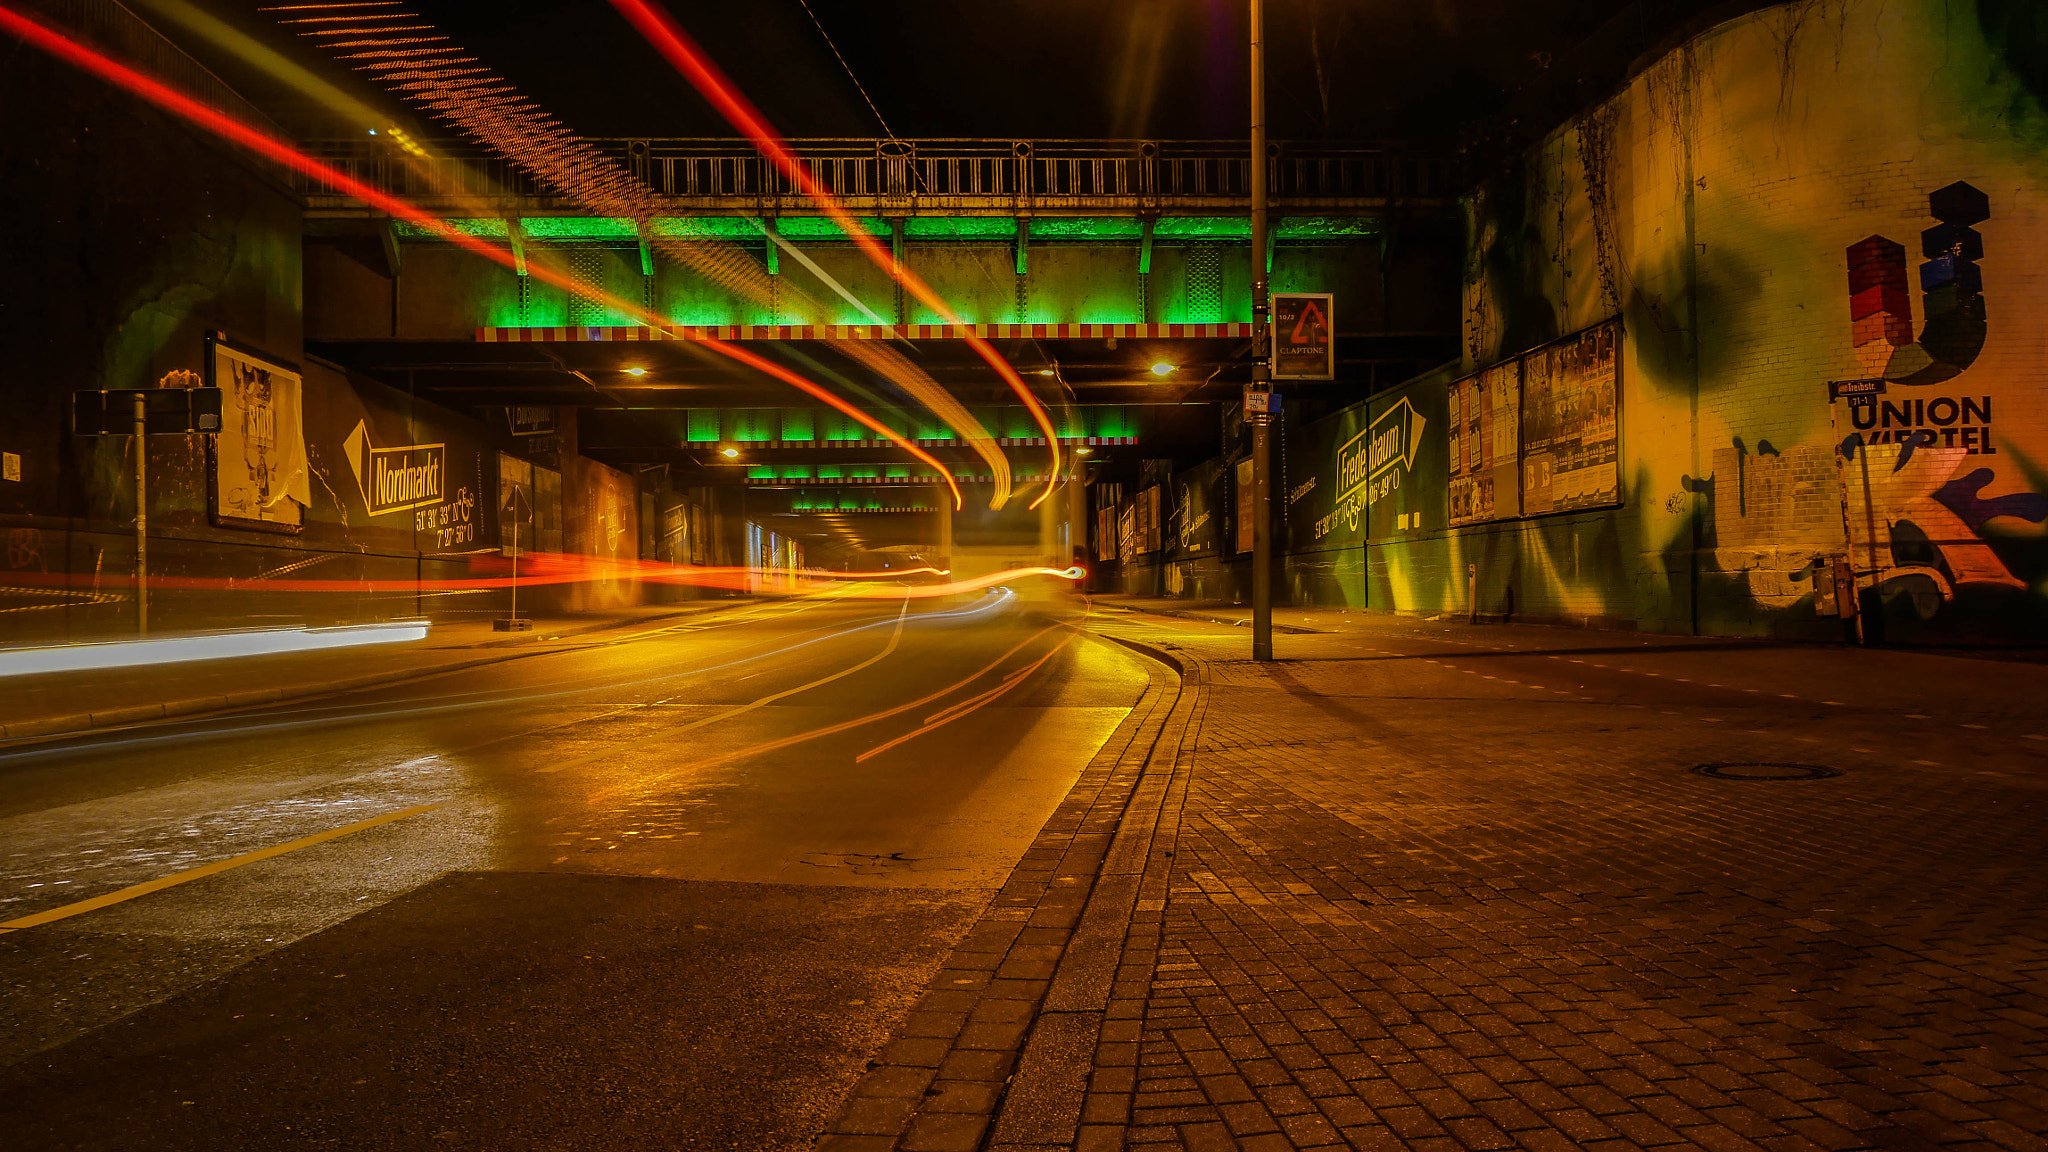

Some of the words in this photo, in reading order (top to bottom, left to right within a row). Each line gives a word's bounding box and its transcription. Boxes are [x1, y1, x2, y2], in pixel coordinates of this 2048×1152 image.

[1847, 382, 1876, 392] Treibstr.
[1852, 396, 1991, 430] UNION
[375, 451, 438, 506] Nordmarkt
[1341, 425, 1399, 492] Fredenbaum
